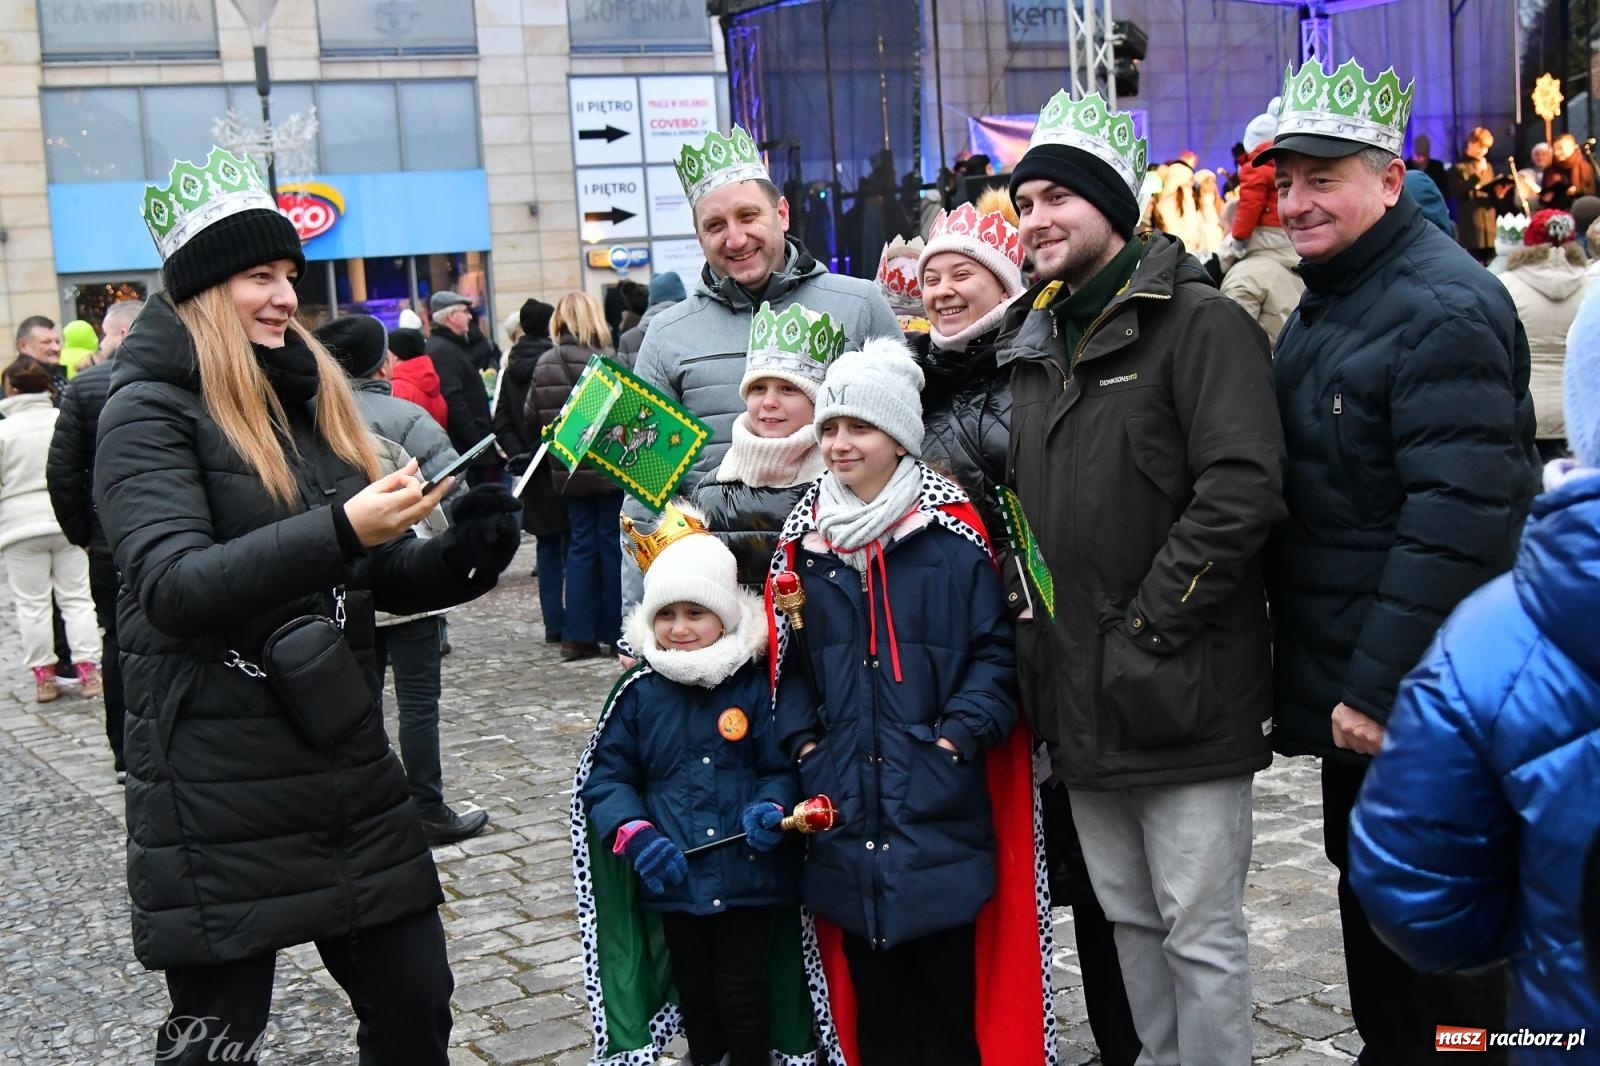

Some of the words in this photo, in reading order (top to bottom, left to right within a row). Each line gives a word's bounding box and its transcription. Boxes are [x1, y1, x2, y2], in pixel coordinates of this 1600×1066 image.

[52, 1, 203, 25] KAWIARNIA
[576, 101, 585, 113] II
[588, 99, 633, 115] PIĘTRO
[649, 117, 699, 130] COVEBO
[592, 181, 637, 197] PIĘTRO
[825, 384, 849, 408] M
